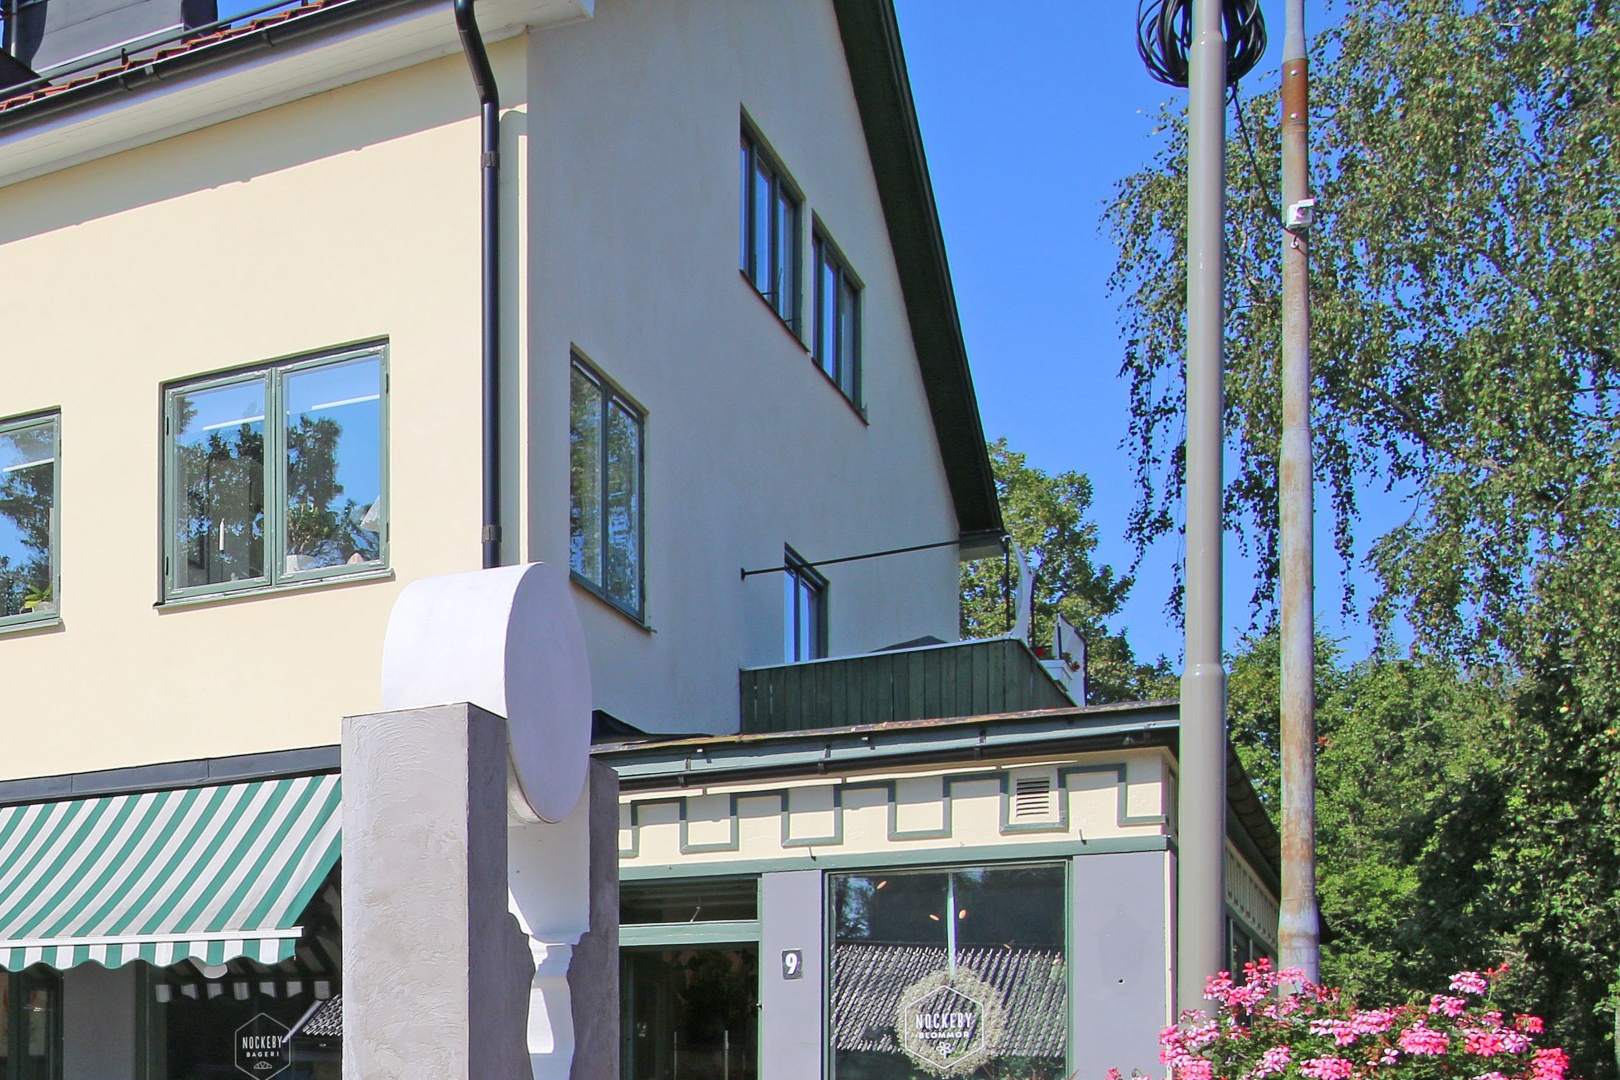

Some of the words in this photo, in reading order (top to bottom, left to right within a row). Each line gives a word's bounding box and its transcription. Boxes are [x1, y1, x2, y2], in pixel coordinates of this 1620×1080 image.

[785, 952, 798, 975] 9
[915, 1012, 973, 1029] NOCKEBY
[242, 1035, 283, 1049] NOCKEBY
[919, 1031, 970, 1039] BLOMMOR
